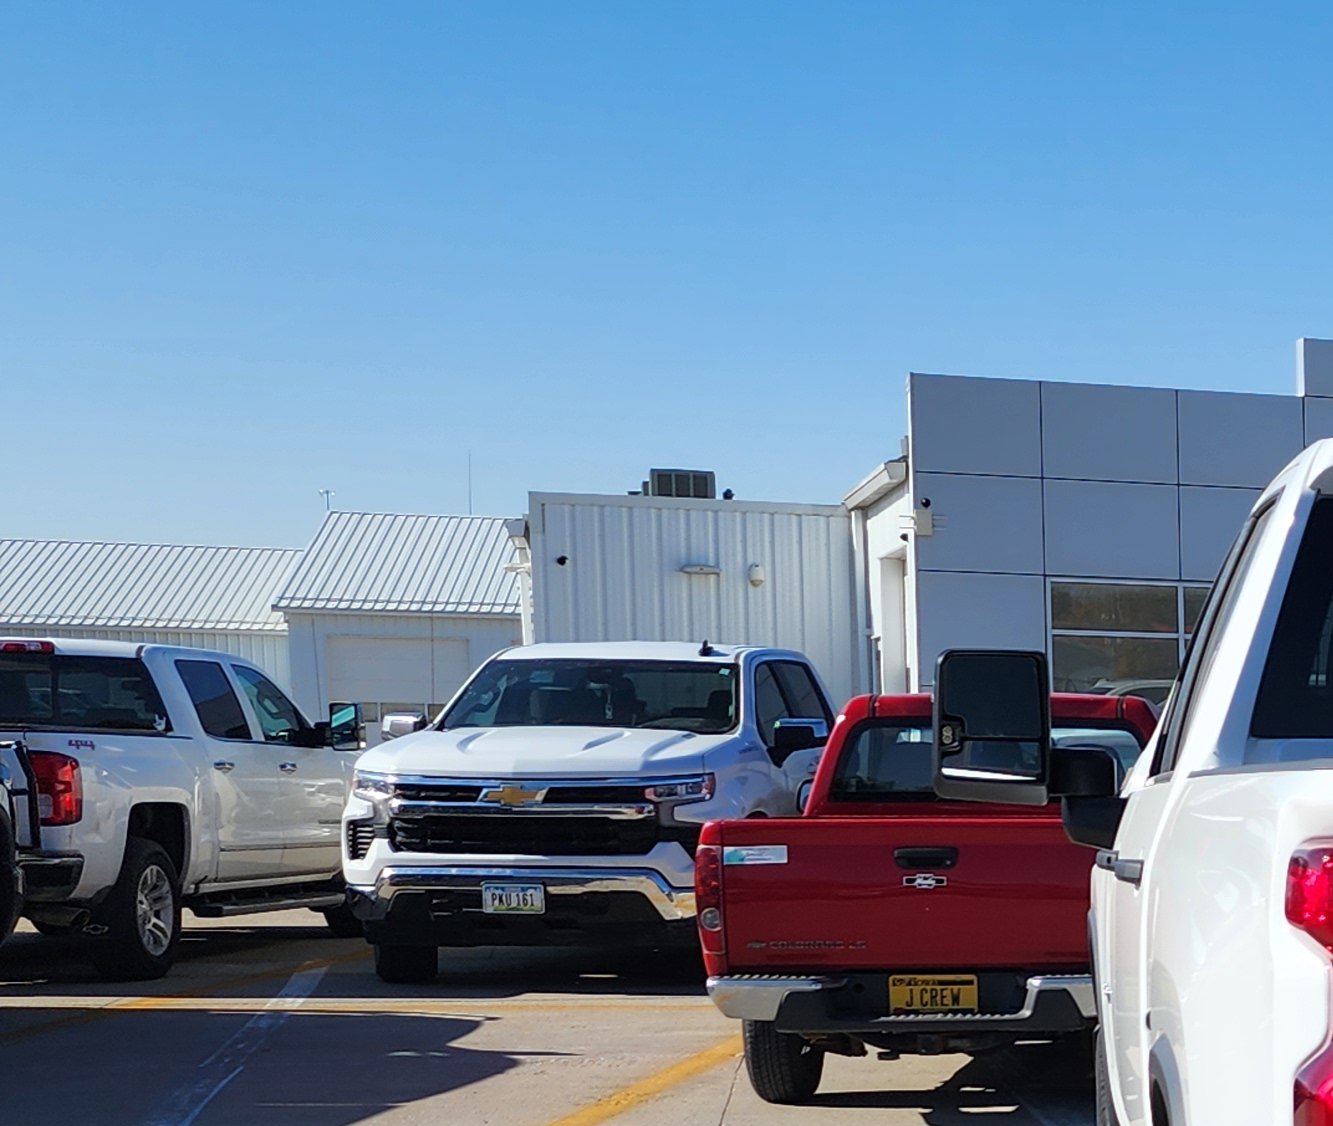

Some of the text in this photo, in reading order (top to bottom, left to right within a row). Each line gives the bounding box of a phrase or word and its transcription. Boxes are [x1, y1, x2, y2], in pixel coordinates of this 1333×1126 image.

[491, 893, 535, 907] PKU 161
[905, 988, 961, 1007] J CREW
